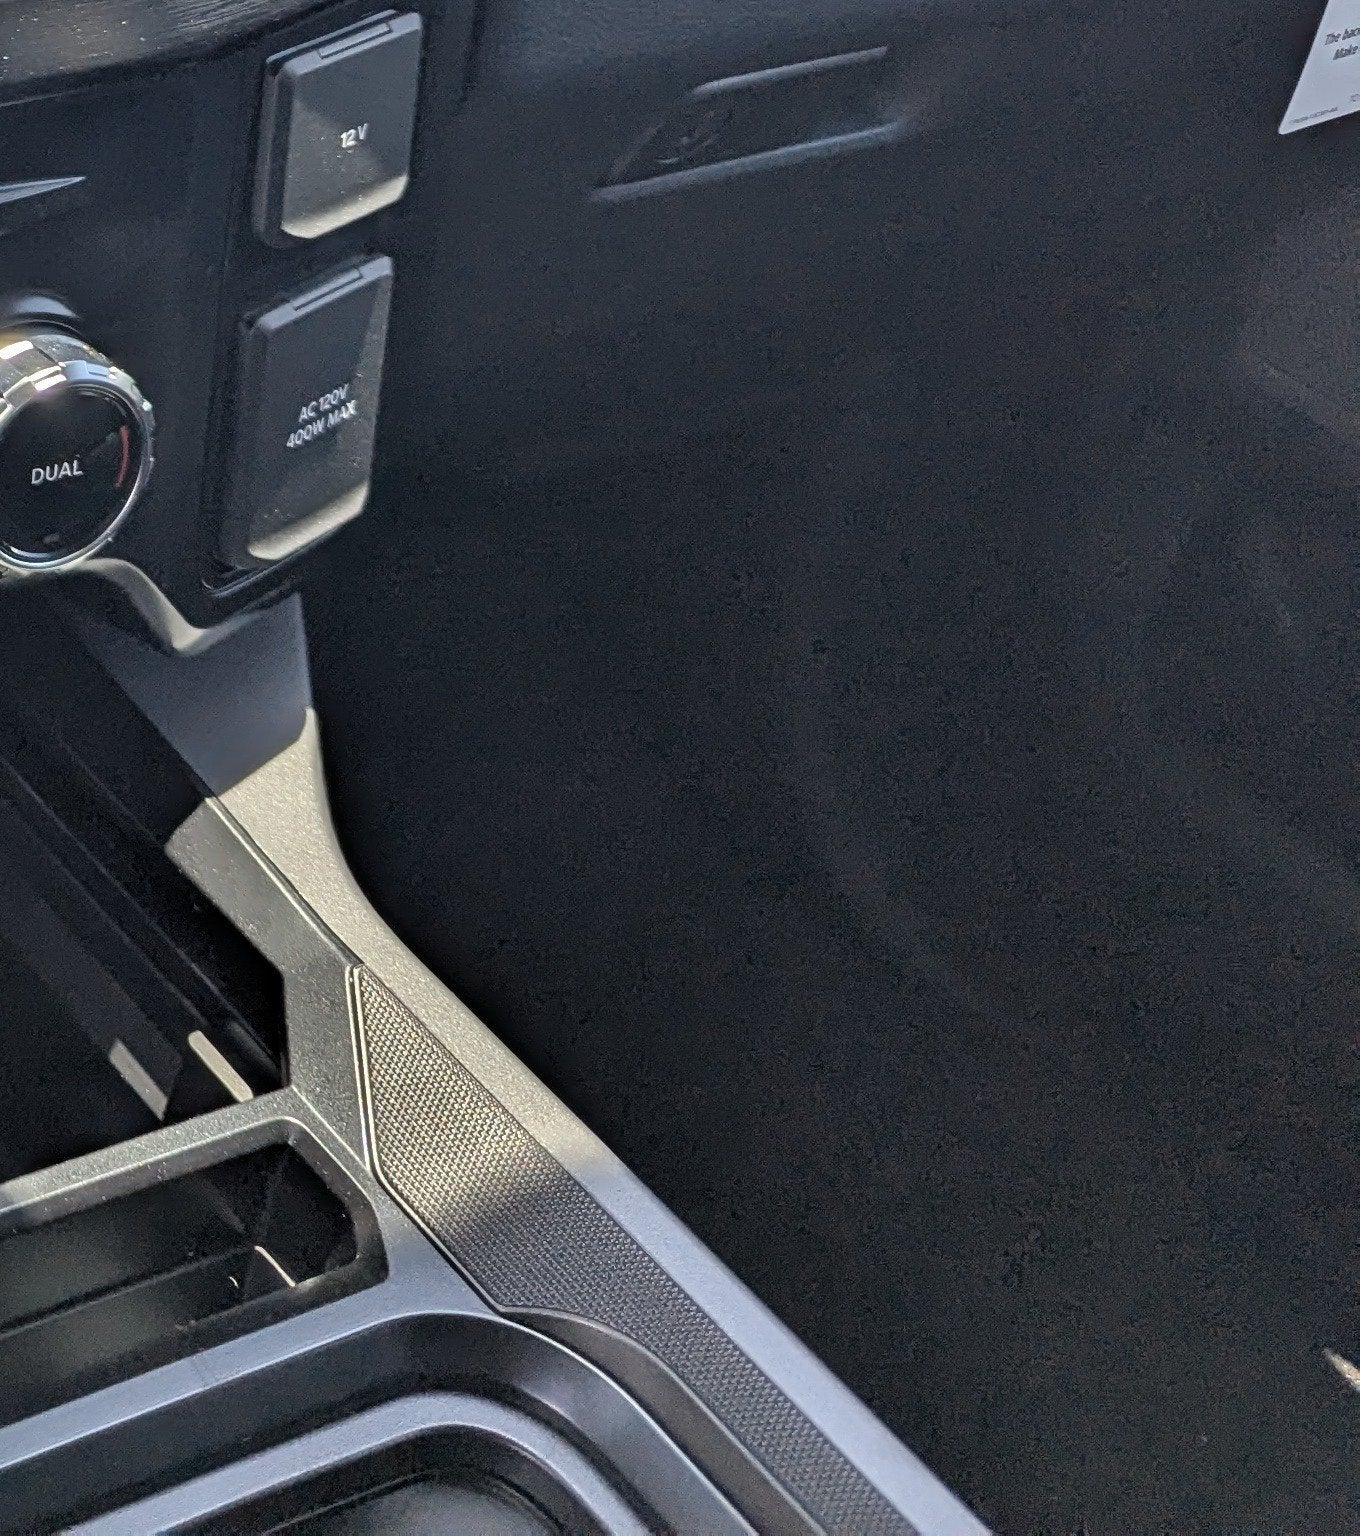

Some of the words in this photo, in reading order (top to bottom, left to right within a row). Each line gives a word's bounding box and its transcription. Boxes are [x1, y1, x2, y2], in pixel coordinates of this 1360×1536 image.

[299, 401, 318, 422] AC
[319, 383, 349, 412] 120V
[286, 417, 325, 448] 400W
[326, 399, 357, 428] MAX
[30, 459, 84, 485] DUAL
